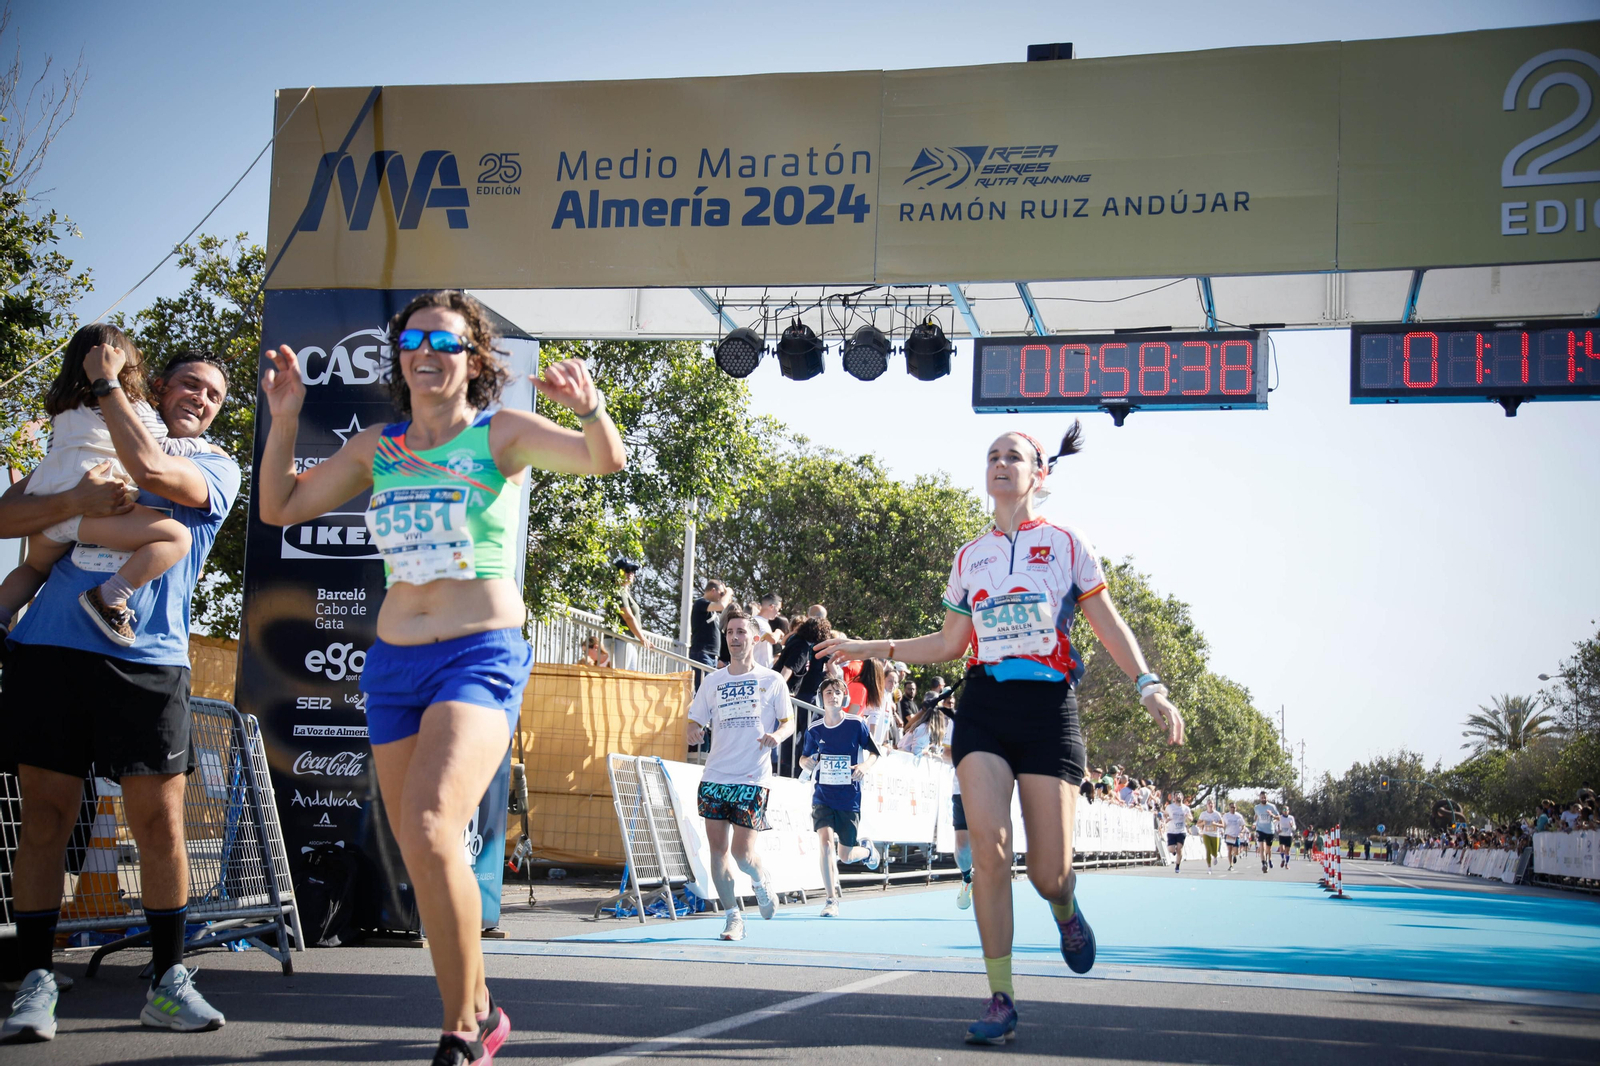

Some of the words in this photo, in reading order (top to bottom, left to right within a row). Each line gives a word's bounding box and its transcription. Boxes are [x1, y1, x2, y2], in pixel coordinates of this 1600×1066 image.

[1502, 48, 1600, 188] 2
[988, 144, 1058, 163] RFEA
[477, 153, 522, 184] 25
[557, 148, 677, 182] Medio
[698, 143, 871, 178] Maratón
[981, 162, 1051, 176] SERIES
[974, 176, 1019, 188] RUTA
[1022, 174, 1091, 187] RUNNING
[476, 185, 521, 195] EDICIÓN
[552, 187, 731, 229] Almería
[742, 184, 871, 226] 2024
[900, 196, 1006, 222] RAMÓN
[1021, 198, 1089, 219] RUIZ
[1101, 189, 1250, 216] ANDÚJAR
[1502, 198, 1600, 235] EDI
[375, 502, 453, 537] 5551
[404, 532, 423, 540] VIVI
[317, 588, 367, 600] Barceló
[316, 603, 348, 616] Cabo
[351, 603, 367, 616] de
[981, 602, 1042, 628] 5481
[315, 618, 345, 630] Gata
[1011, 622, 1032, 631] BELEN
[305, 642, 367, 681] ego
[721, 685, 755, 700] 5443
[296, 697, 332, 710] SER
[294, 727, 306, 735] La
[307, 727, 323, 736] Voz
[324, 727, 336, 736] de
[292, 750, 368, 777] Coca-Cola
[823, 760, 848, 769] 5142
[290, 789, 363, 810] Andalucía
